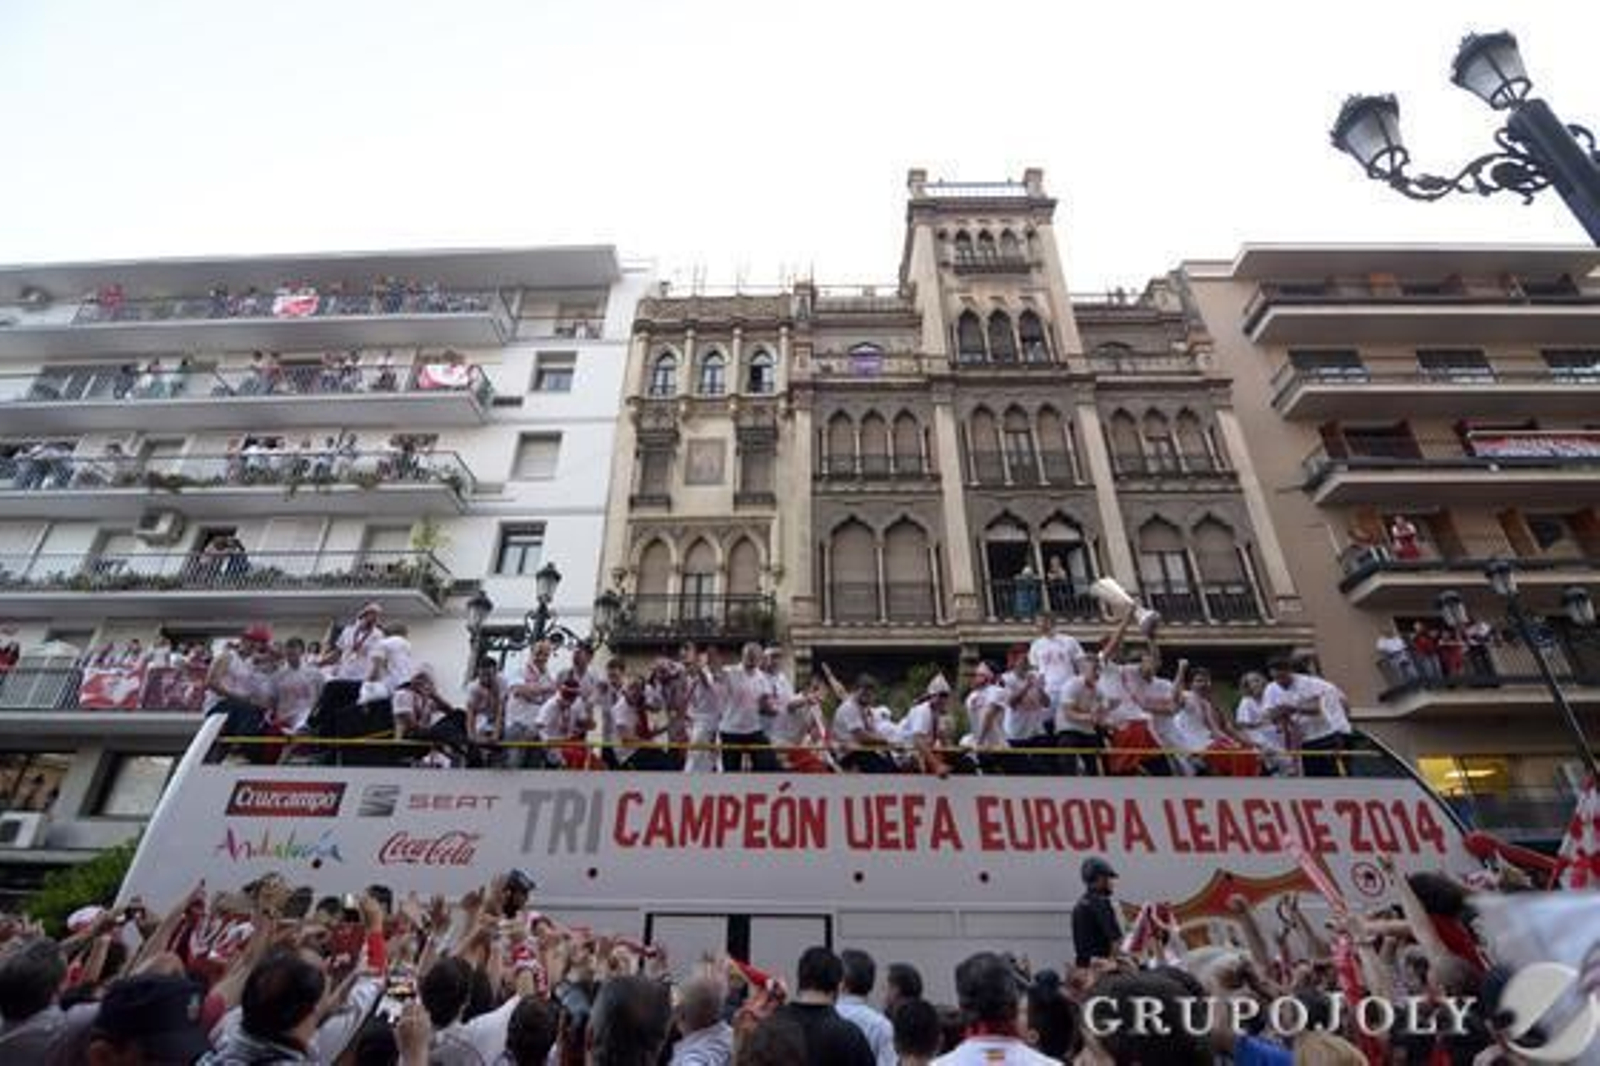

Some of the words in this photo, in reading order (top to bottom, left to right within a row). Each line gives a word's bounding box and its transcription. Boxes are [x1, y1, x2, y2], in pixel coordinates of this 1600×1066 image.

[408, 793, 501, 811] SEAT
[518, 788, 604, 856] TRI
[612, 782, 827, 849] CAMPEÓN
[844, 795, 964, 851] UEFA
[976, 795, 1155, 853] EUROPA
[1163, 798, 1338, 854] LEAGUE
[1333, 799, 1447, 854] 2014
